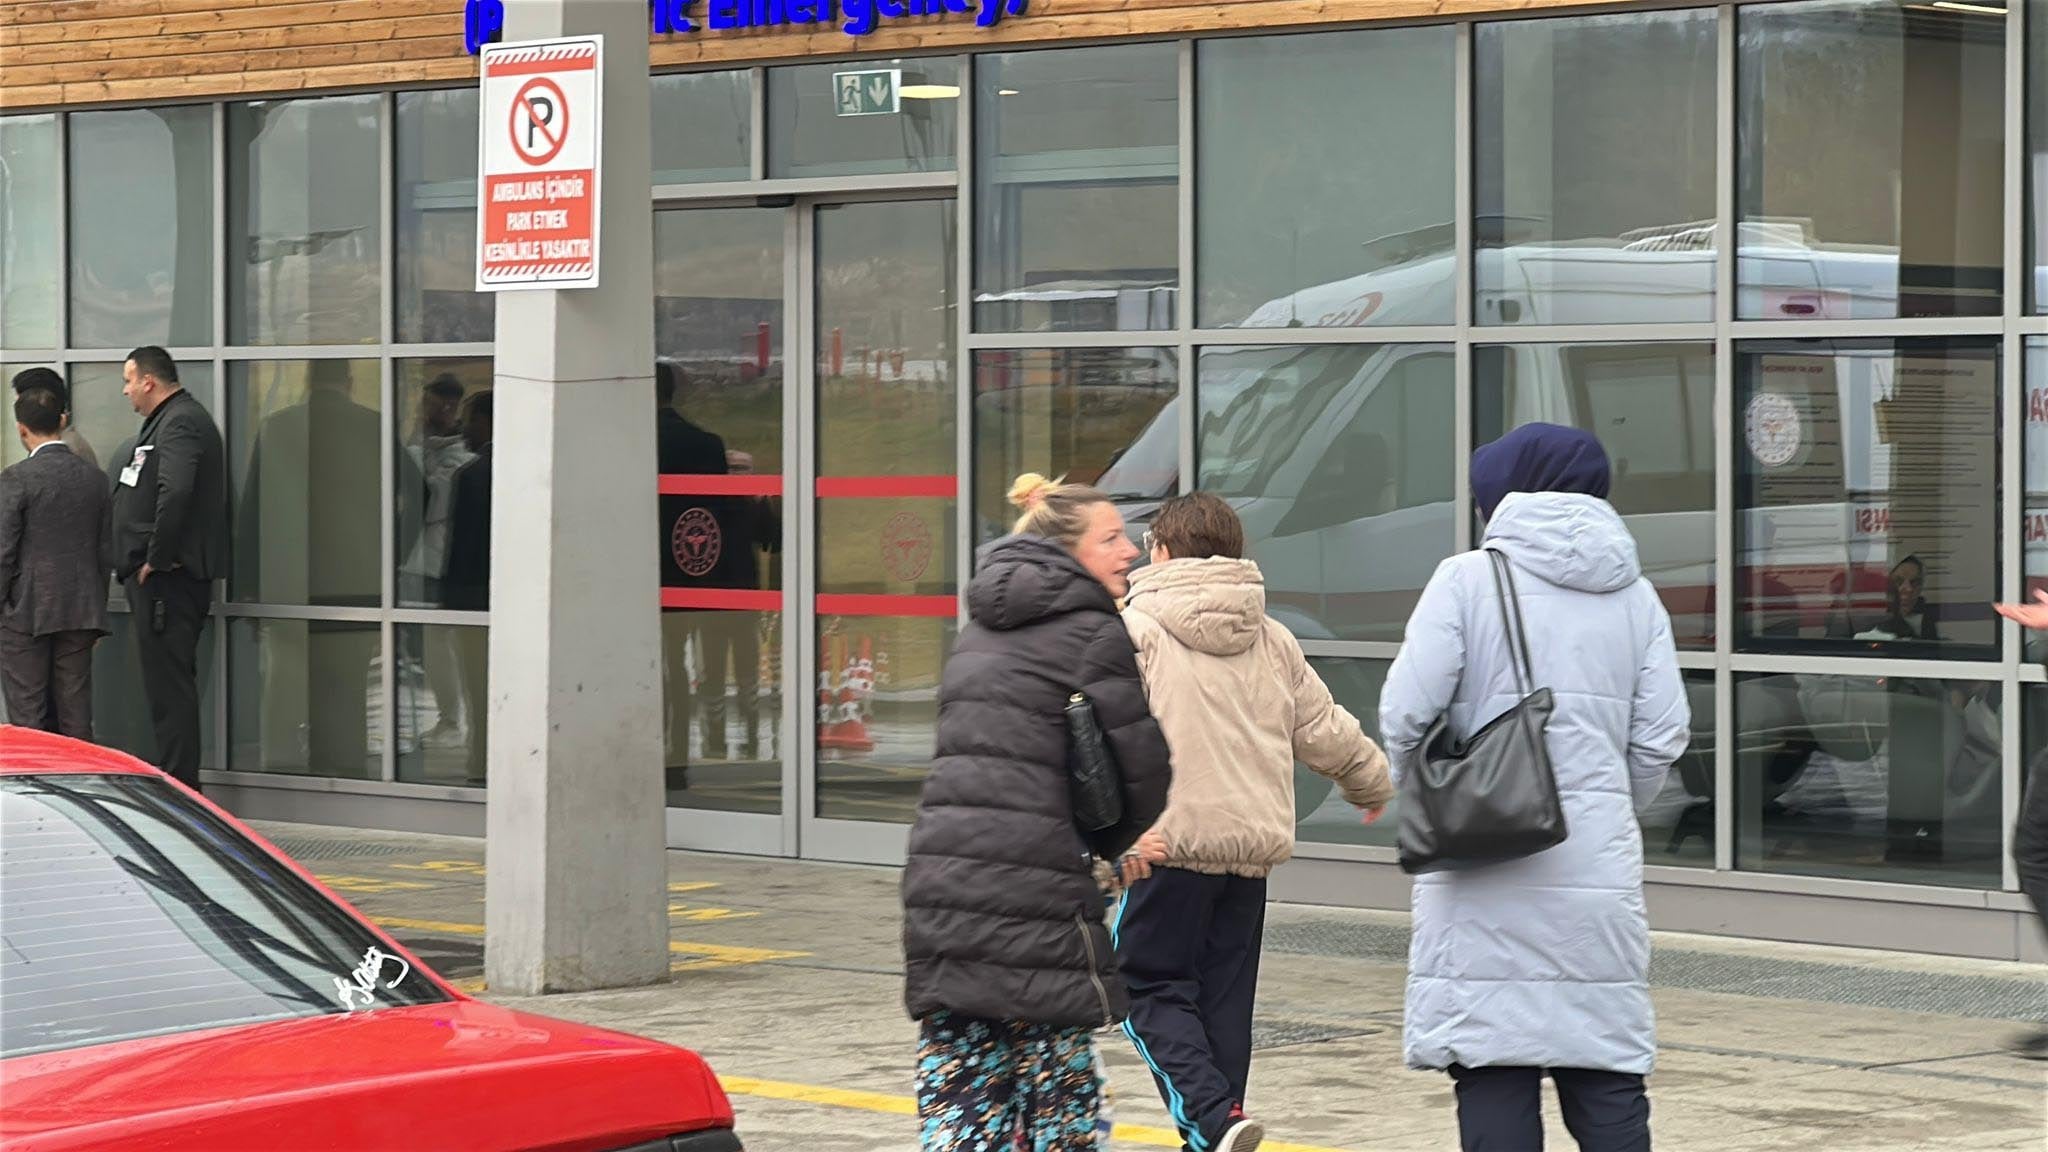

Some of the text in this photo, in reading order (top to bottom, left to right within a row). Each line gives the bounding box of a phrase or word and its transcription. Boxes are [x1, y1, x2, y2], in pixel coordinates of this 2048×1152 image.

[493, 180, 544, 202] AMBULANS
[506, 209, 569, 232] PARK ETMEK
